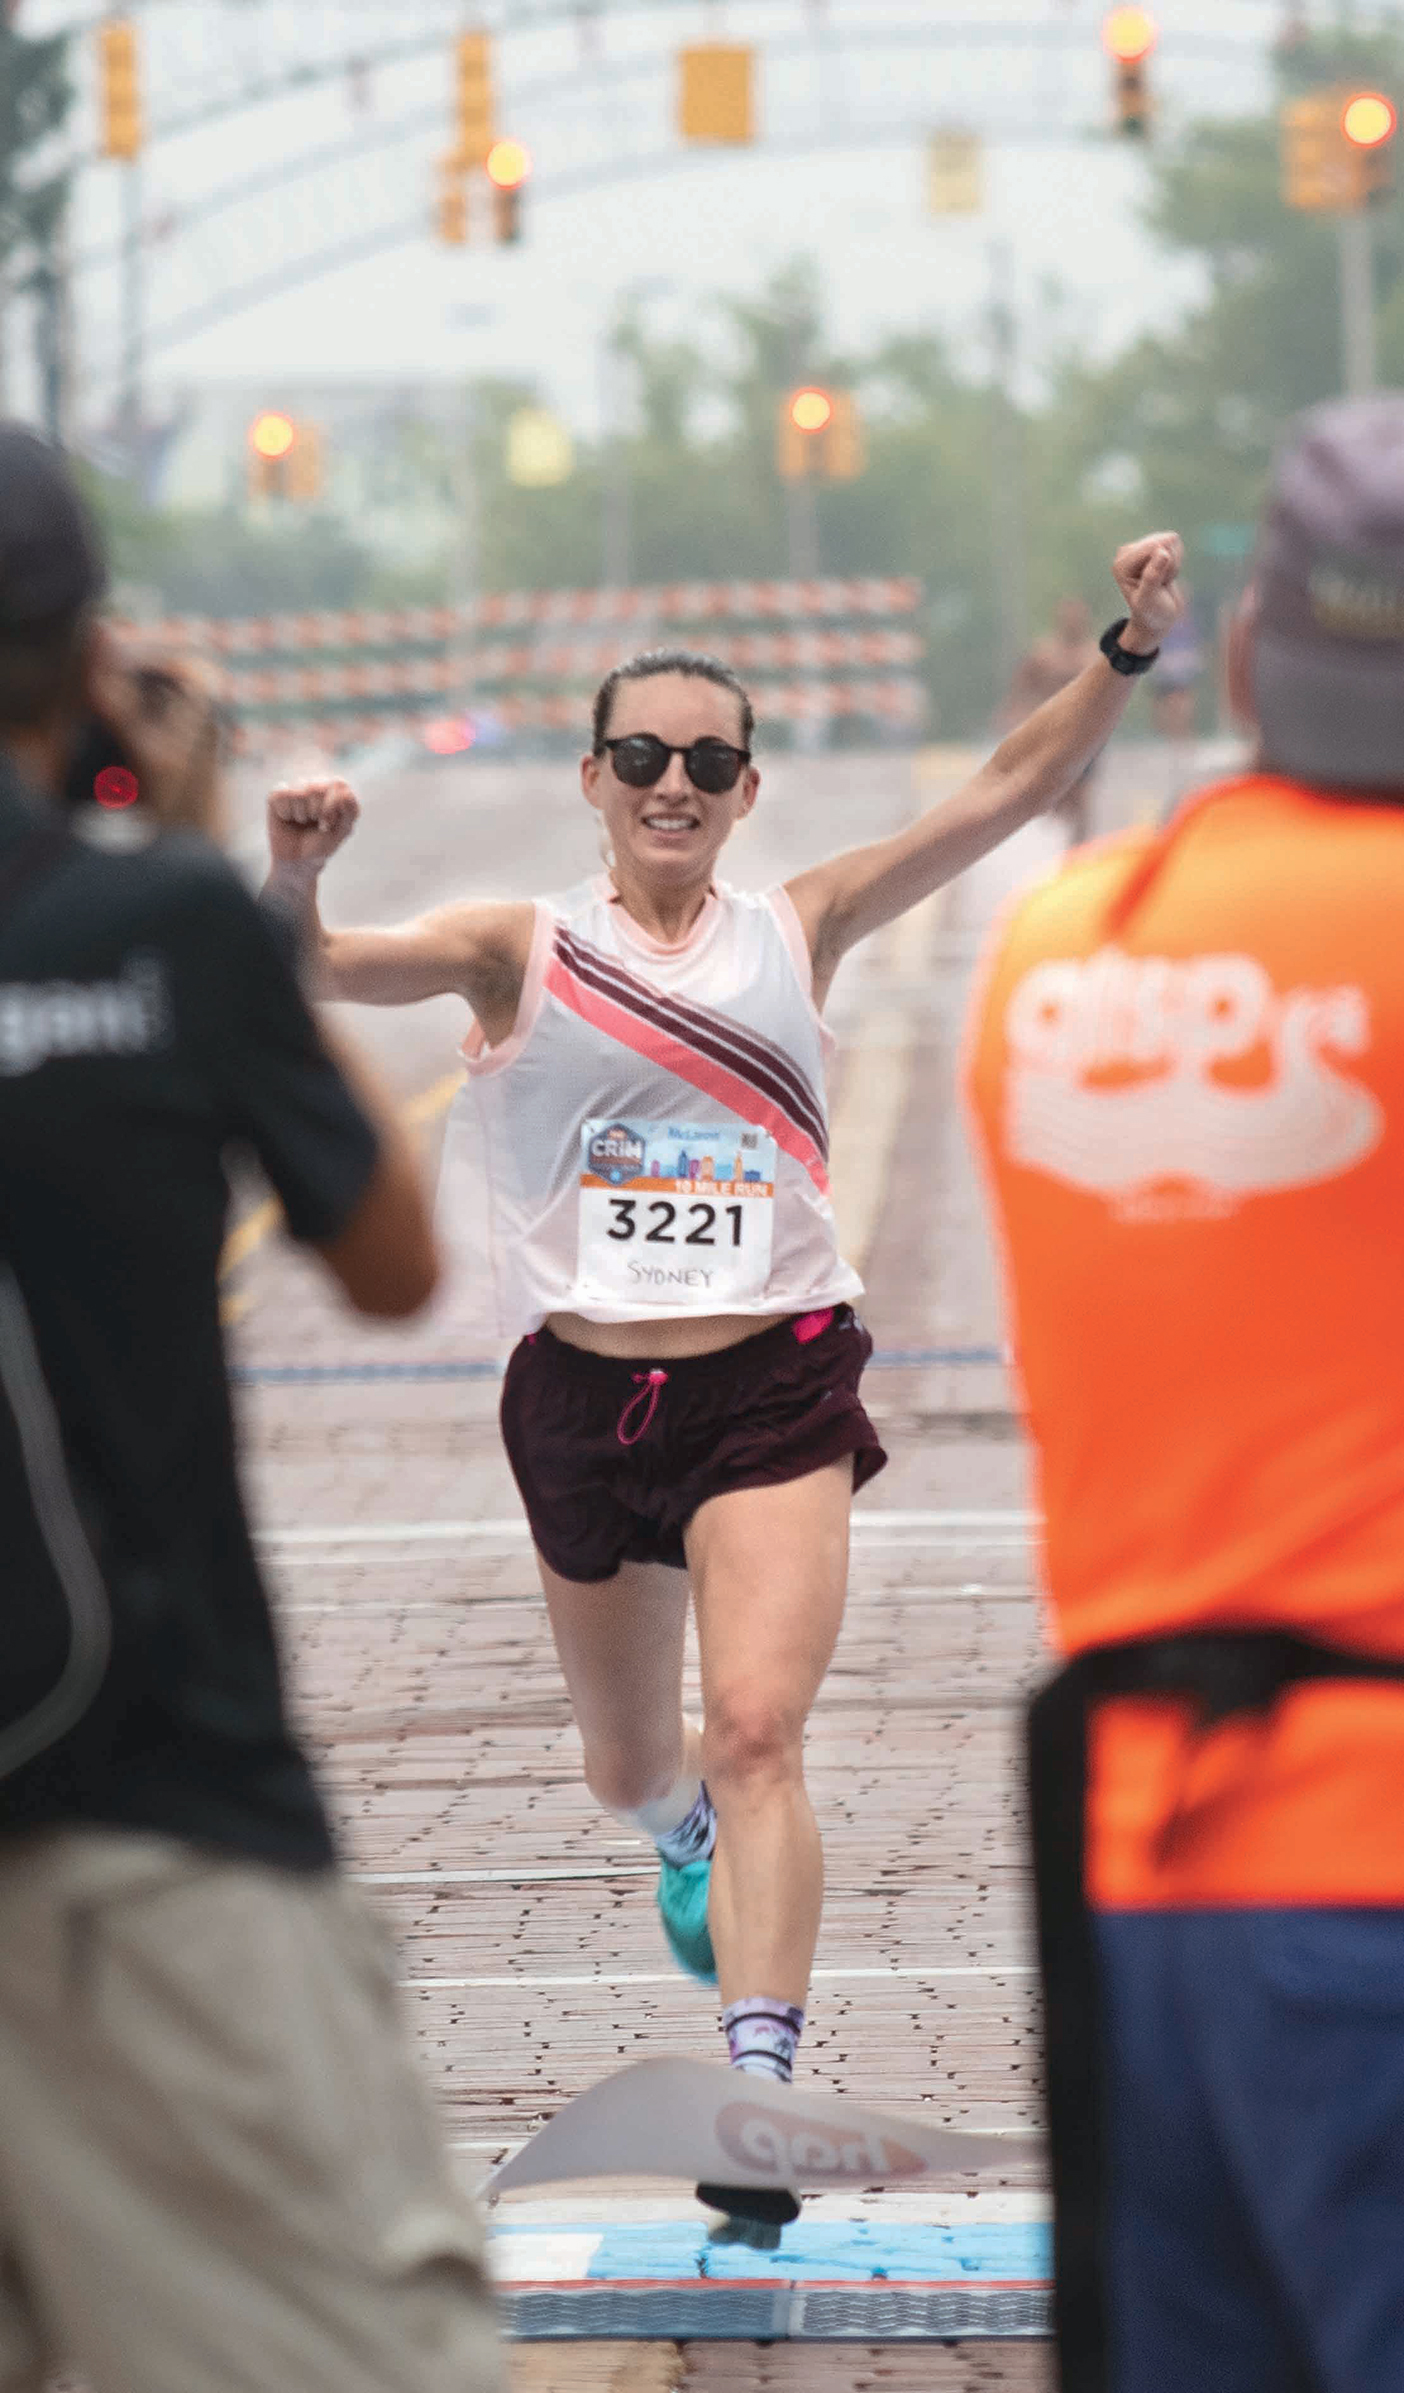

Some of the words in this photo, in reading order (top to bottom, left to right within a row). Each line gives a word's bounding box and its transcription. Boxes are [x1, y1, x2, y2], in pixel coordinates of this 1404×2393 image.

[675, 1180, 692, 1193] 10
[695, 1182, 732, 1195] MILE
[734, 1183, 769, 1196] RUN
[606, 1198, 743, 1246] 3221
